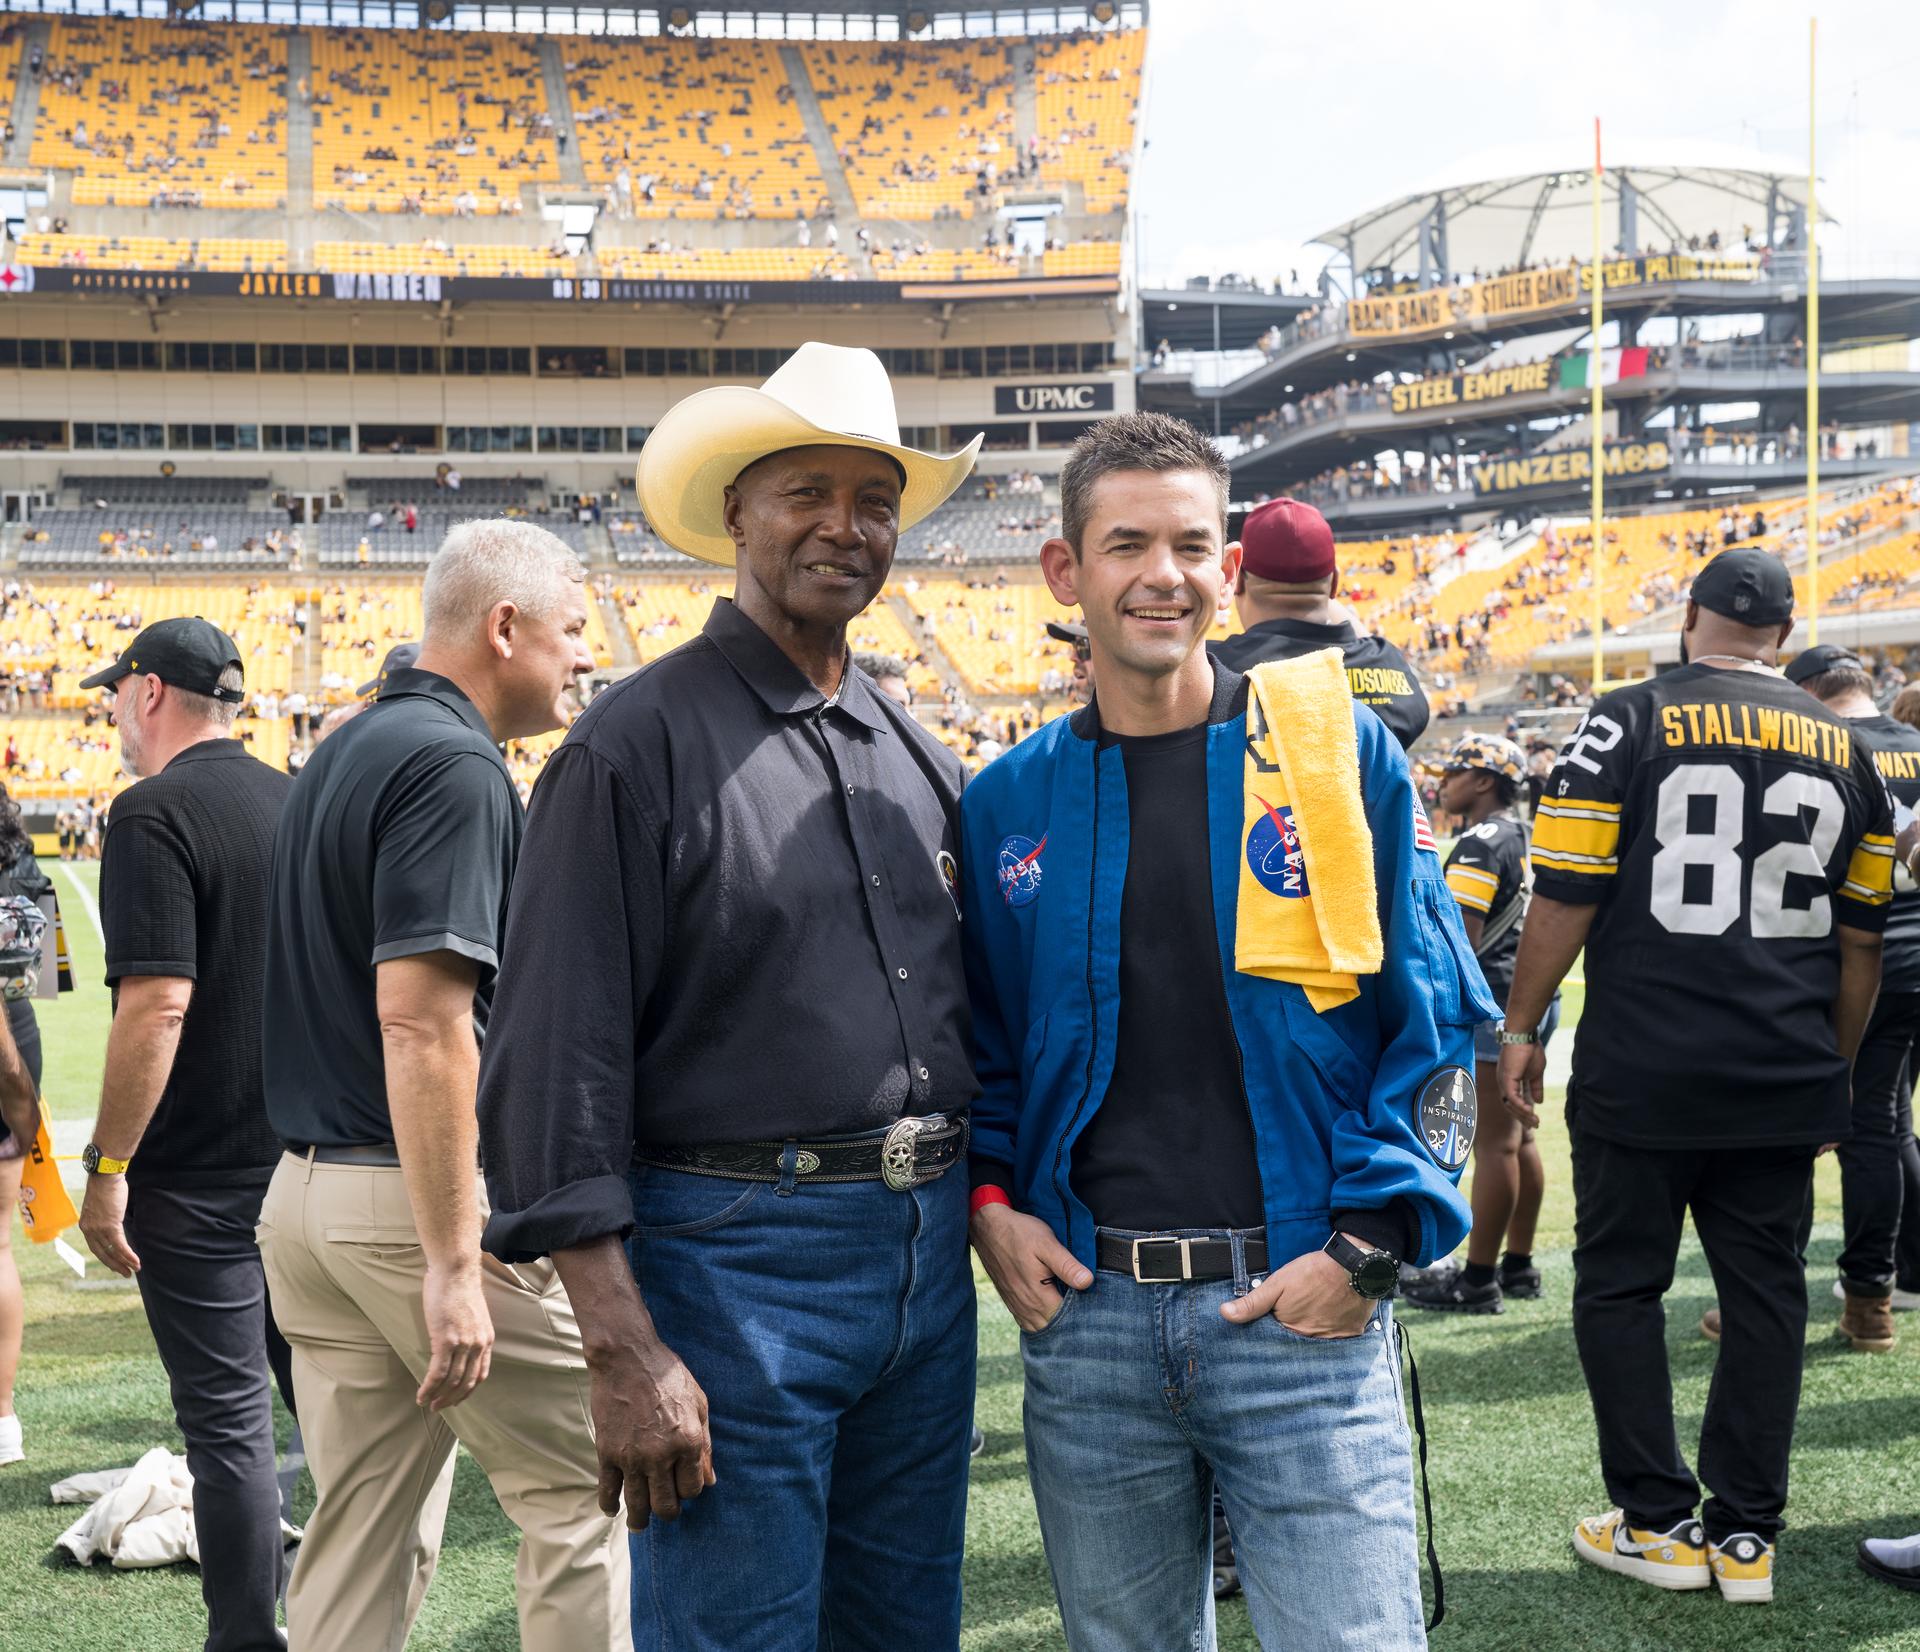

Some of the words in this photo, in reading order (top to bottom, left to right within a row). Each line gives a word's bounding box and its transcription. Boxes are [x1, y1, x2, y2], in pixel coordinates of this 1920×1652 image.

[239, 274, 320, 296] JAYLEN
[333, 273, 441, 301] WARREN
[1398, 294, 1440, 328] BANG
[1482, 278, 1532, 313] STILLER
[1015, 385, 1095, 411] UPMC
[1391, 378, 1459, 412] STEEL
[1463, 362, 1552, 400] EMPIRE
[1473, 451, 1591, 492] YINZER
[1661, 703, 1851, 769] STALLWORTH
[998, 859, 1042, 882] NASA
[1650, 764, 1846, 938] 82
